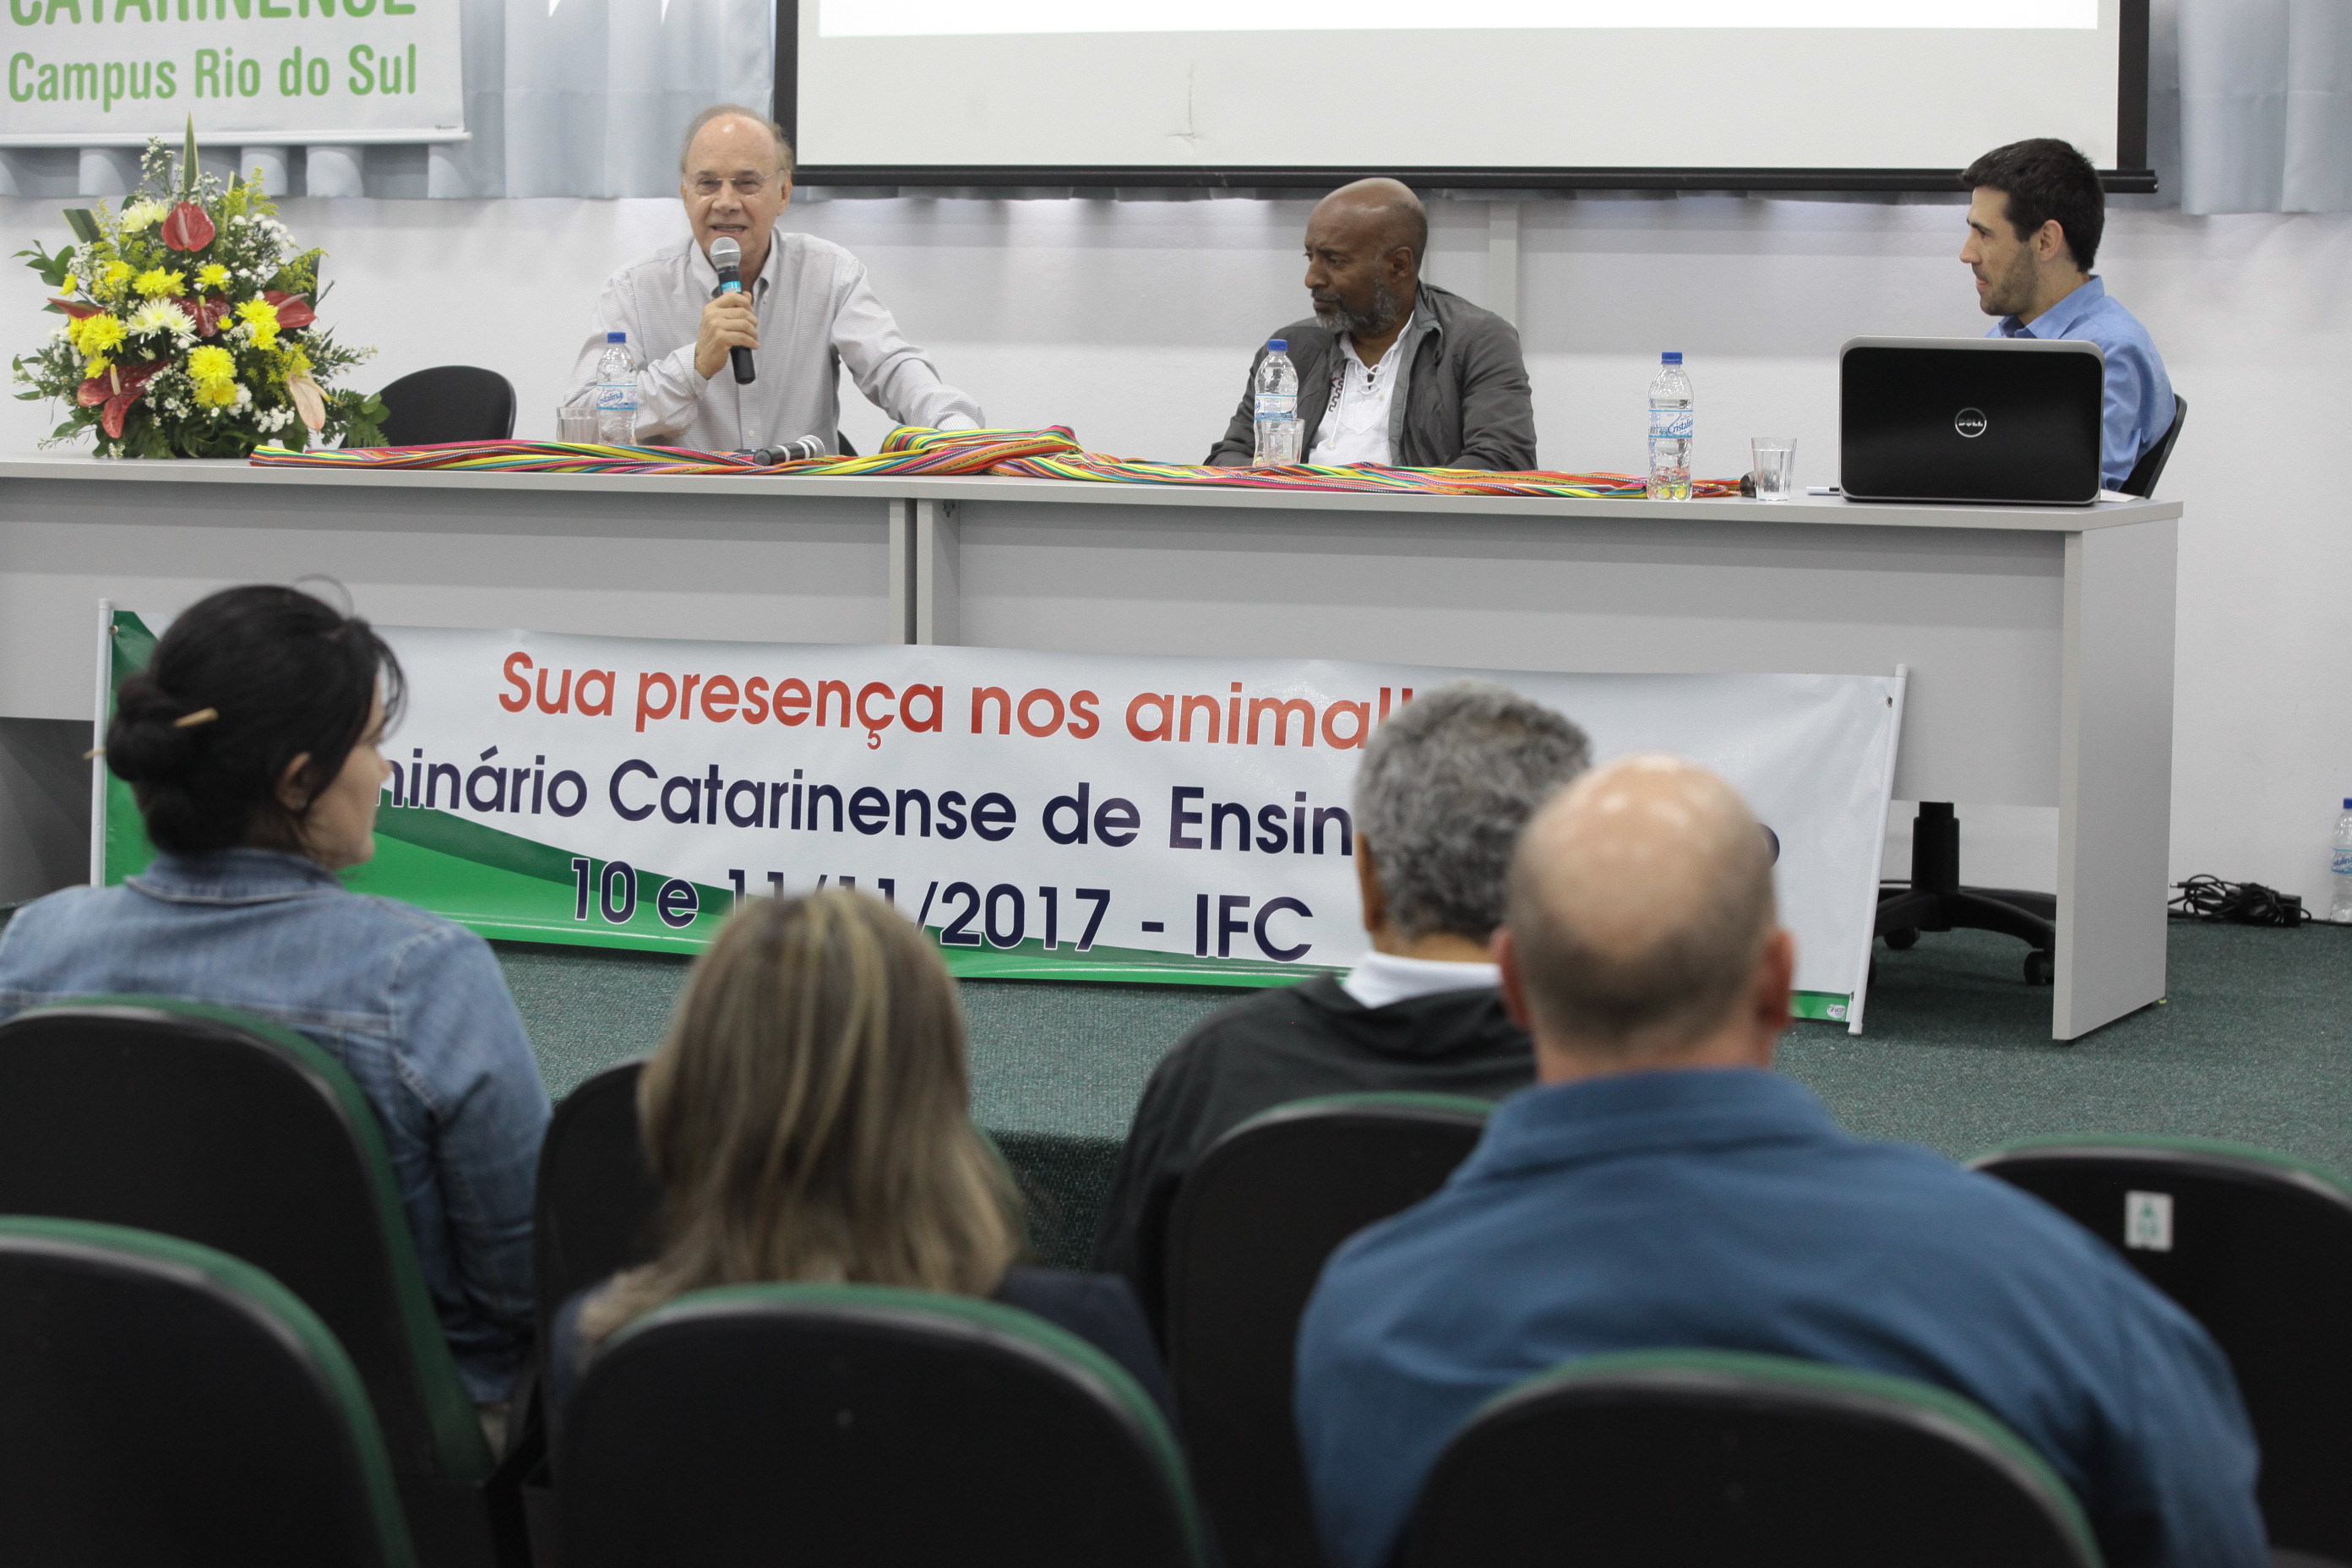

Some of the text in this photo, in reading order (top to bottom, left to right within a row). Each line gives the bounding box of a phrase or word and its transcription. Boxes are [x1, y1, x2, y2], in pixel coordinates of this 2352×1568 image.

[10, 44, 416, 112] Campus Rio do Sul
[498, 651, 617, 717] Sua
[635, 671, 944, 750] presença
[971, 685, 1101, 740] nos
[381, 744, 1353, 857] inário Catarinense de Ensin
[572, 858, 637, 924] 10
[657, 879, 699, 928] e
[727, 868, 1112, 951] 111/2017
[1195, 893, 1315, 962] IFC
